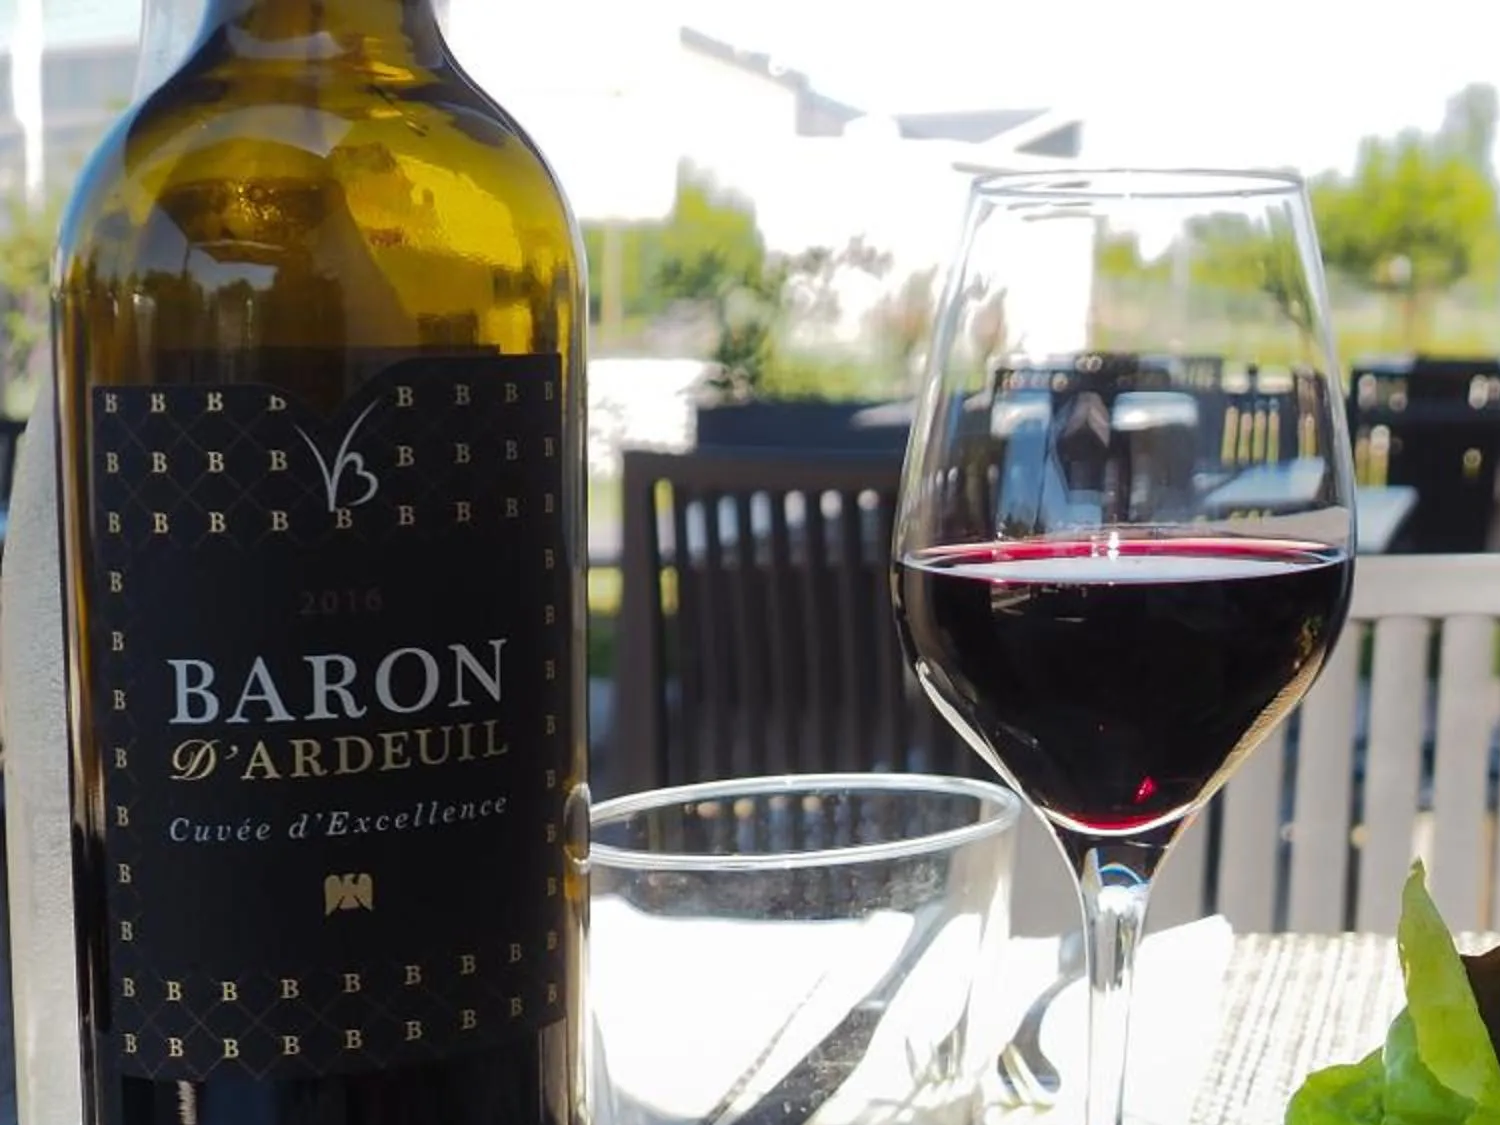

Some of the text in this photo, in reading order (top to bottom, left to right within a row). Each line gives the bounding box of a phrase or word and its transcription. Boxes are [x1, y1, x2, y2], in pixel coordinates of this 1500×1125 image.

[396, 386, 414, 407] B
[455, 383, 471, 406] B
[504, 382, 519, 403] B
[152, 451, 168, 473] B
[207, 451, 225, 473] B
[269, 449, 288, 471] B
[396, 445, 415, 467] B
[455, 442, 471, 464] B
[505, 439, 518, 461] B
[153, 512, 169, 534] B
[208, 511, 226, 533] B
[271, 510, 289, 532] B
[334, 508, 354, 530] B
[398, 505, 415, 526] B
[455, 501, 472, 523] B
[505, 497, 519, 518] B
[299, 586, 383, 615] 2016
[166, 638, 507, 726] BARON
[168, 720, 508, 782] D'ARDEUIL
[168, 796, 508, 843] Cuvée d'Excellence
[166, 981, 182, 1001] B
[221, 981, 238, 1002] B
[280, 978, 300, 999] B
[343, 973, 361, 993] B
[404, 964, 422, 986] B
[460, 954, 477, 975] B
[509, 943, 523, 963] B
[168, 1037, 184, 1057] B
[223, 1038, 240, 1059] B
[282, 1035, 301, 1056] B
[345, 1029, 363, 1049] B
[405, 1020, 423, 1041] B
[461, 1008, 477, 1030] B
[510, 996, 524, 1017] B
